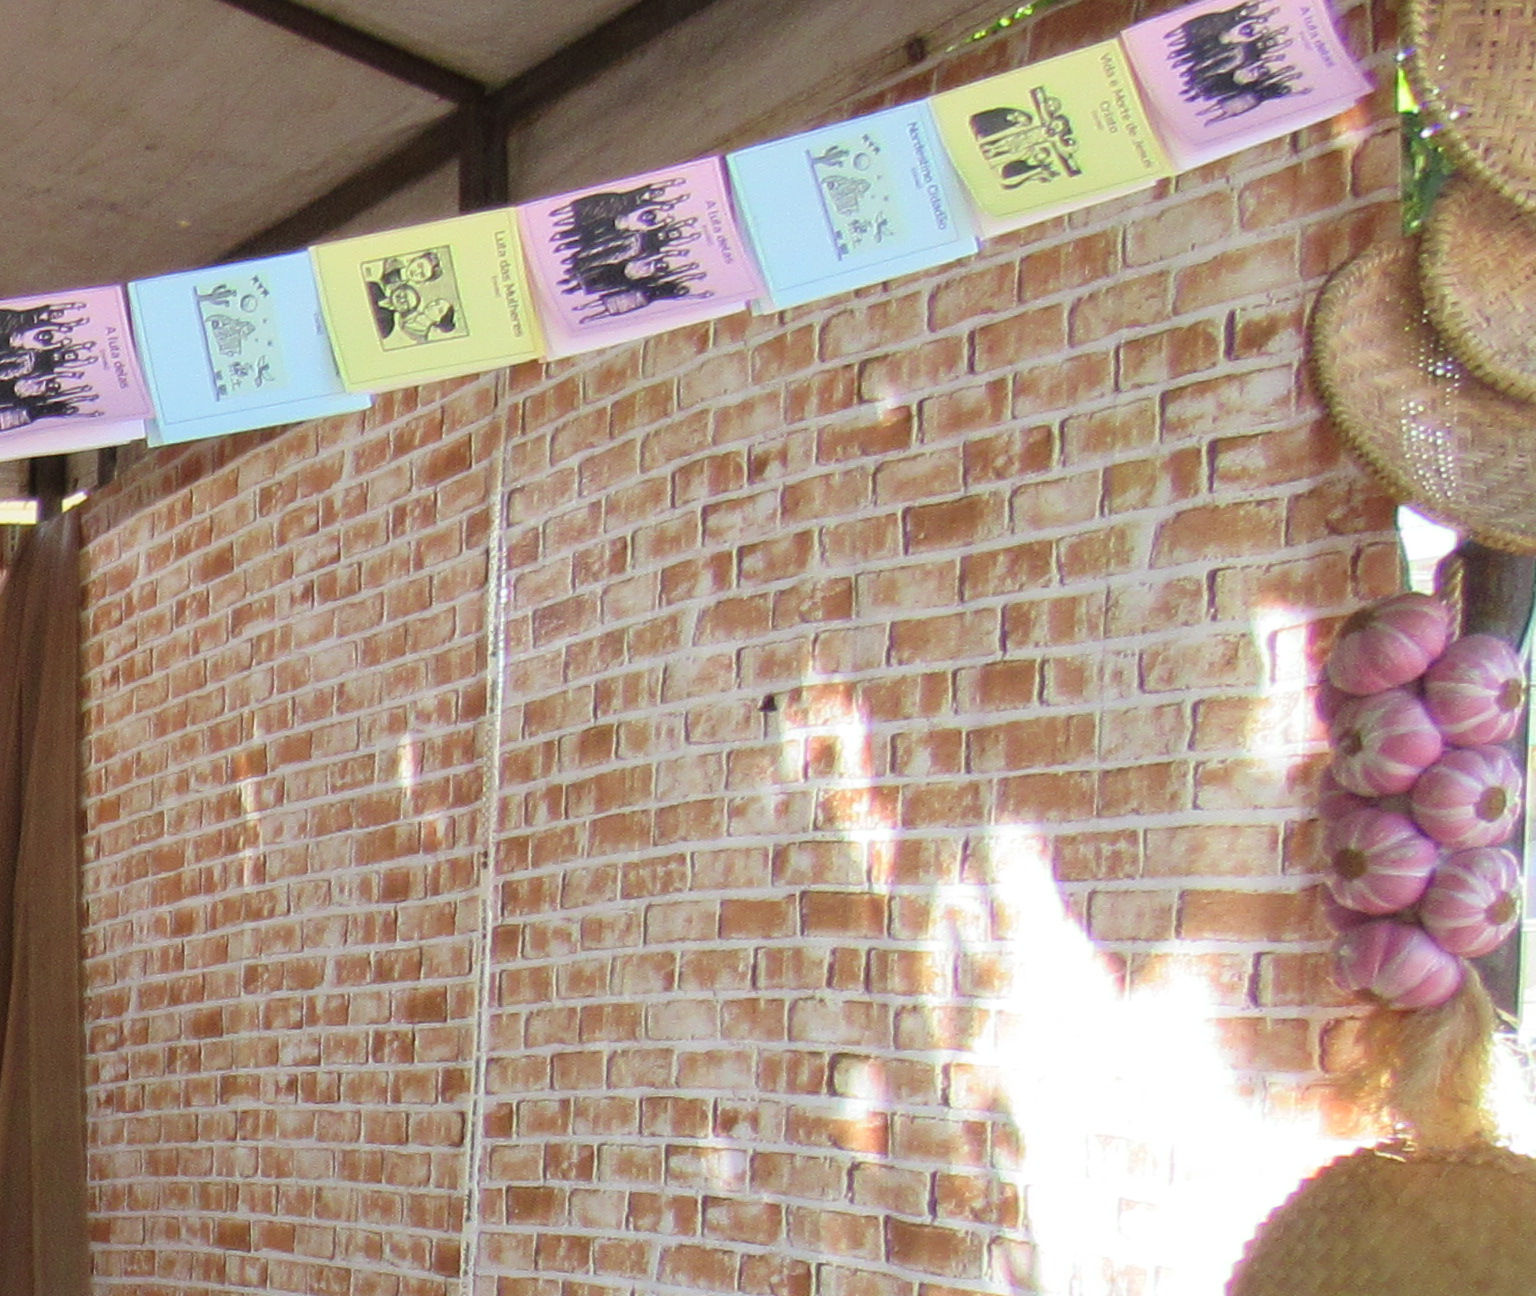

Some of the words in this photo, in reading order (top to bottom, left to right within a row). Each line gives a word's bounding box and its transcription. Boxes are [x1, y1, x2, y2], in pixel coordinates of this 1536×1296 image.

[1300, 6, 1311, 15] A
[1099, 53, 1113, 78] Vida
[1109, 80, 1118, 88] e
[1114, 89, 1130, 120] Morte
[1126, 121, 1137, 136] de
[907, 121, 932, 182] Nordestino
[705, 201, 716, 210] A
[708, 213, 722, 234] luta
[494, 231, 507, 257] Luta
[498, 260, 510, 280] das
[502, 285, 522, 337] Mulheres
[106, 327, 116, 335] A
[108, 338, 120, 359] luta
